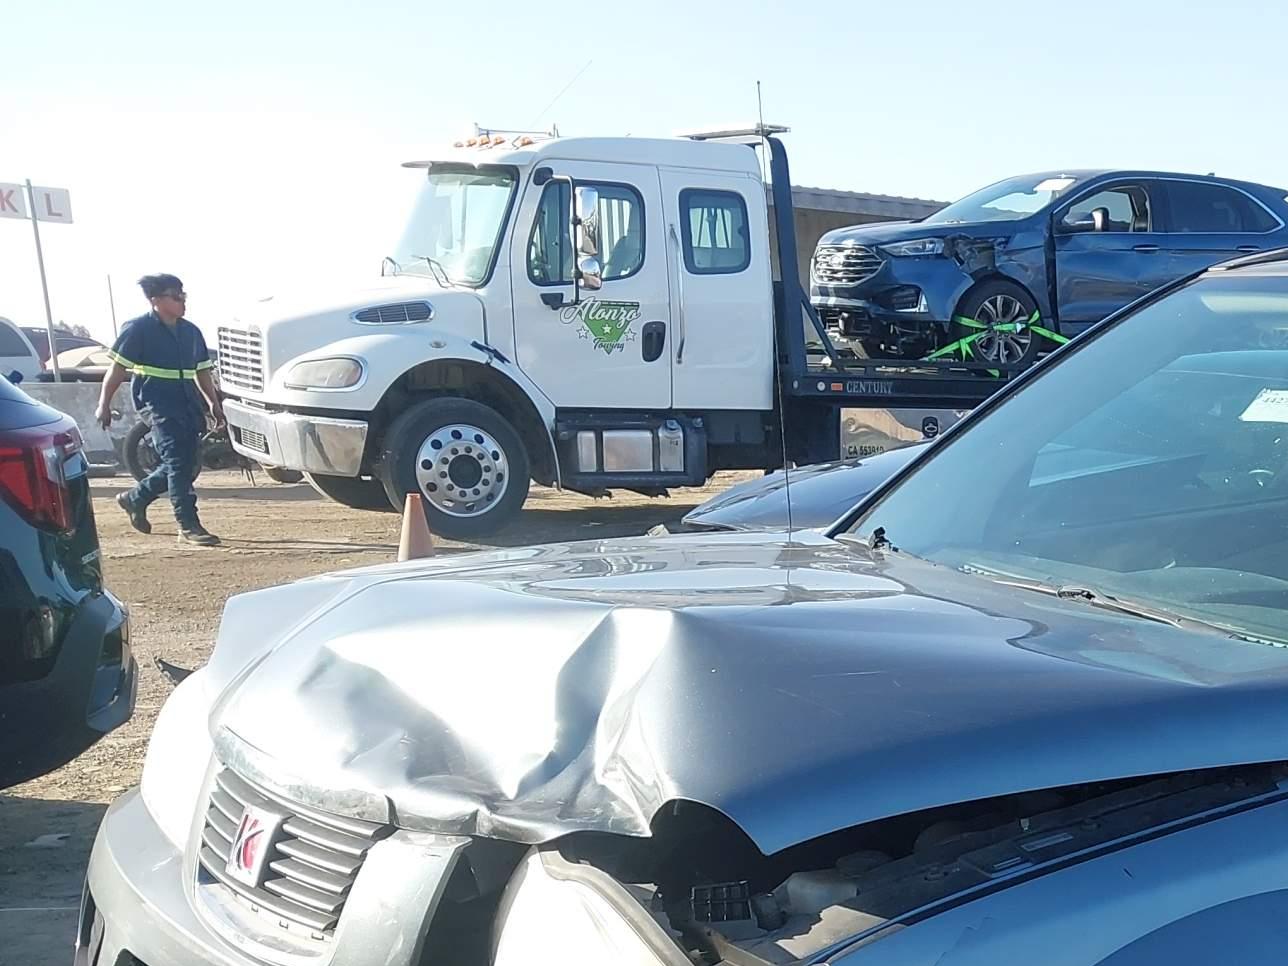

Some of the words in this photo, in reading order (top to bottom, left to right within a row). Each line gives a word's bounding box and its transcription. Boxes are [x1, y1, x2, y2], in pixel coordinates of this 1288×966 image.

[0, 188, 19, 213] K
[44, 192, 63, 217] L
[559, 295, 642, 330] Alonzo
[592, 336, 625, 353] Towing
[847, 380, 894, 394] CENTURY
[848, 446, 858, 456] CA
